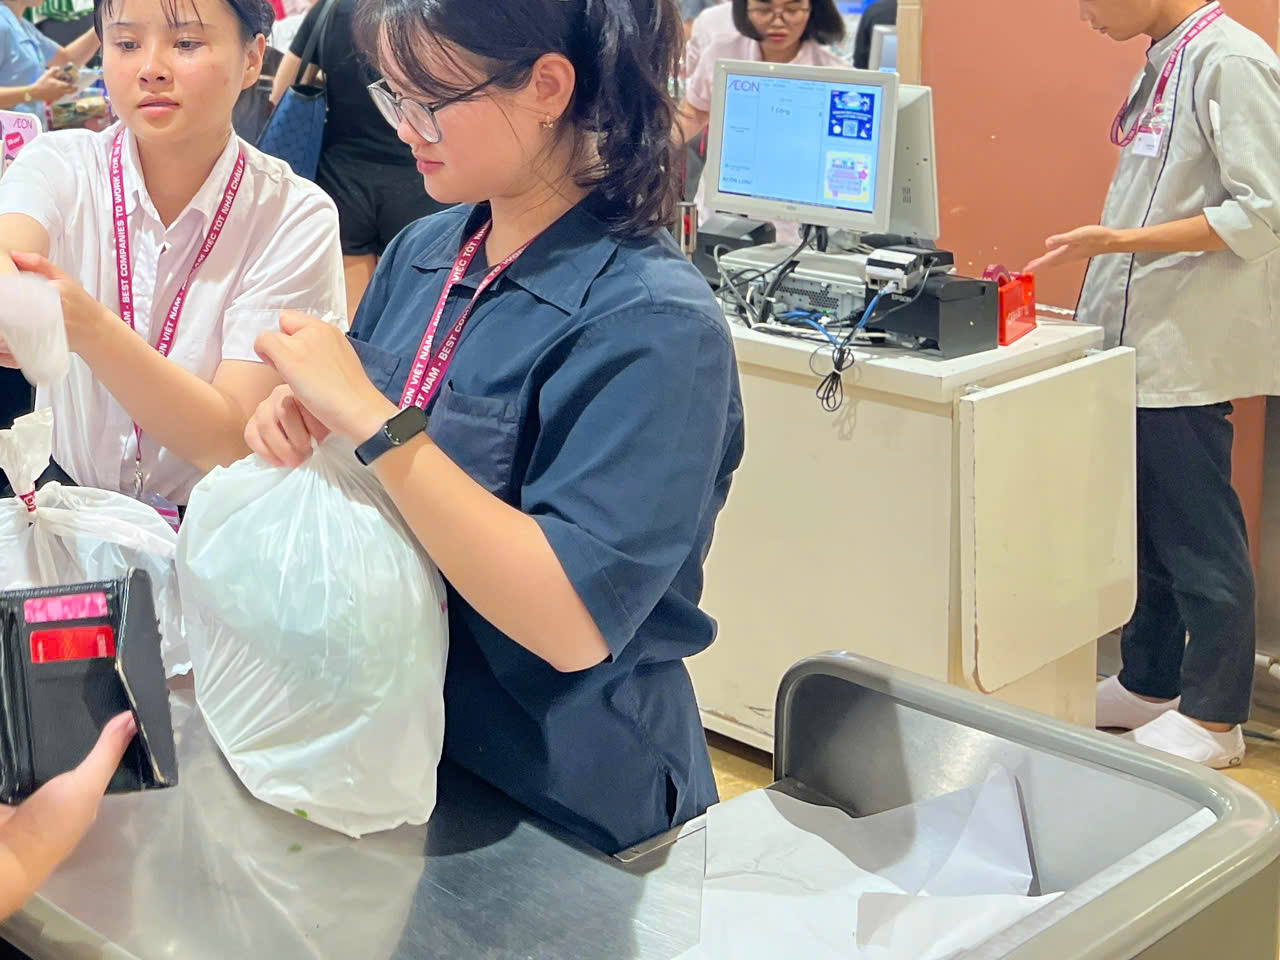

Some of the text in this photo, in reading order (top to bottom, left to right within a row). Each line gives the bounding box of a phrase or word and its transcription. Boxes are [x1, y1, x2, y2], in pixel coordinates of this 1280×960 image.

[112, 175, 123, 204] WORK
[115, 205, 124, 218] TO
[115, 220, 128, 277] COMPANIES
[452, 259, 467, 282] VIỆC
[120, 278, 131, 303] BEST
[169, 296, 182, 320] NAM
[401, 387, 416, 411] EON
[410, 361, 425, 386] VIỆT
[420, 334, 434, 360] NAM
[421, 366, 440, 394] NAM
[438, 334, 458, 361] BEST
